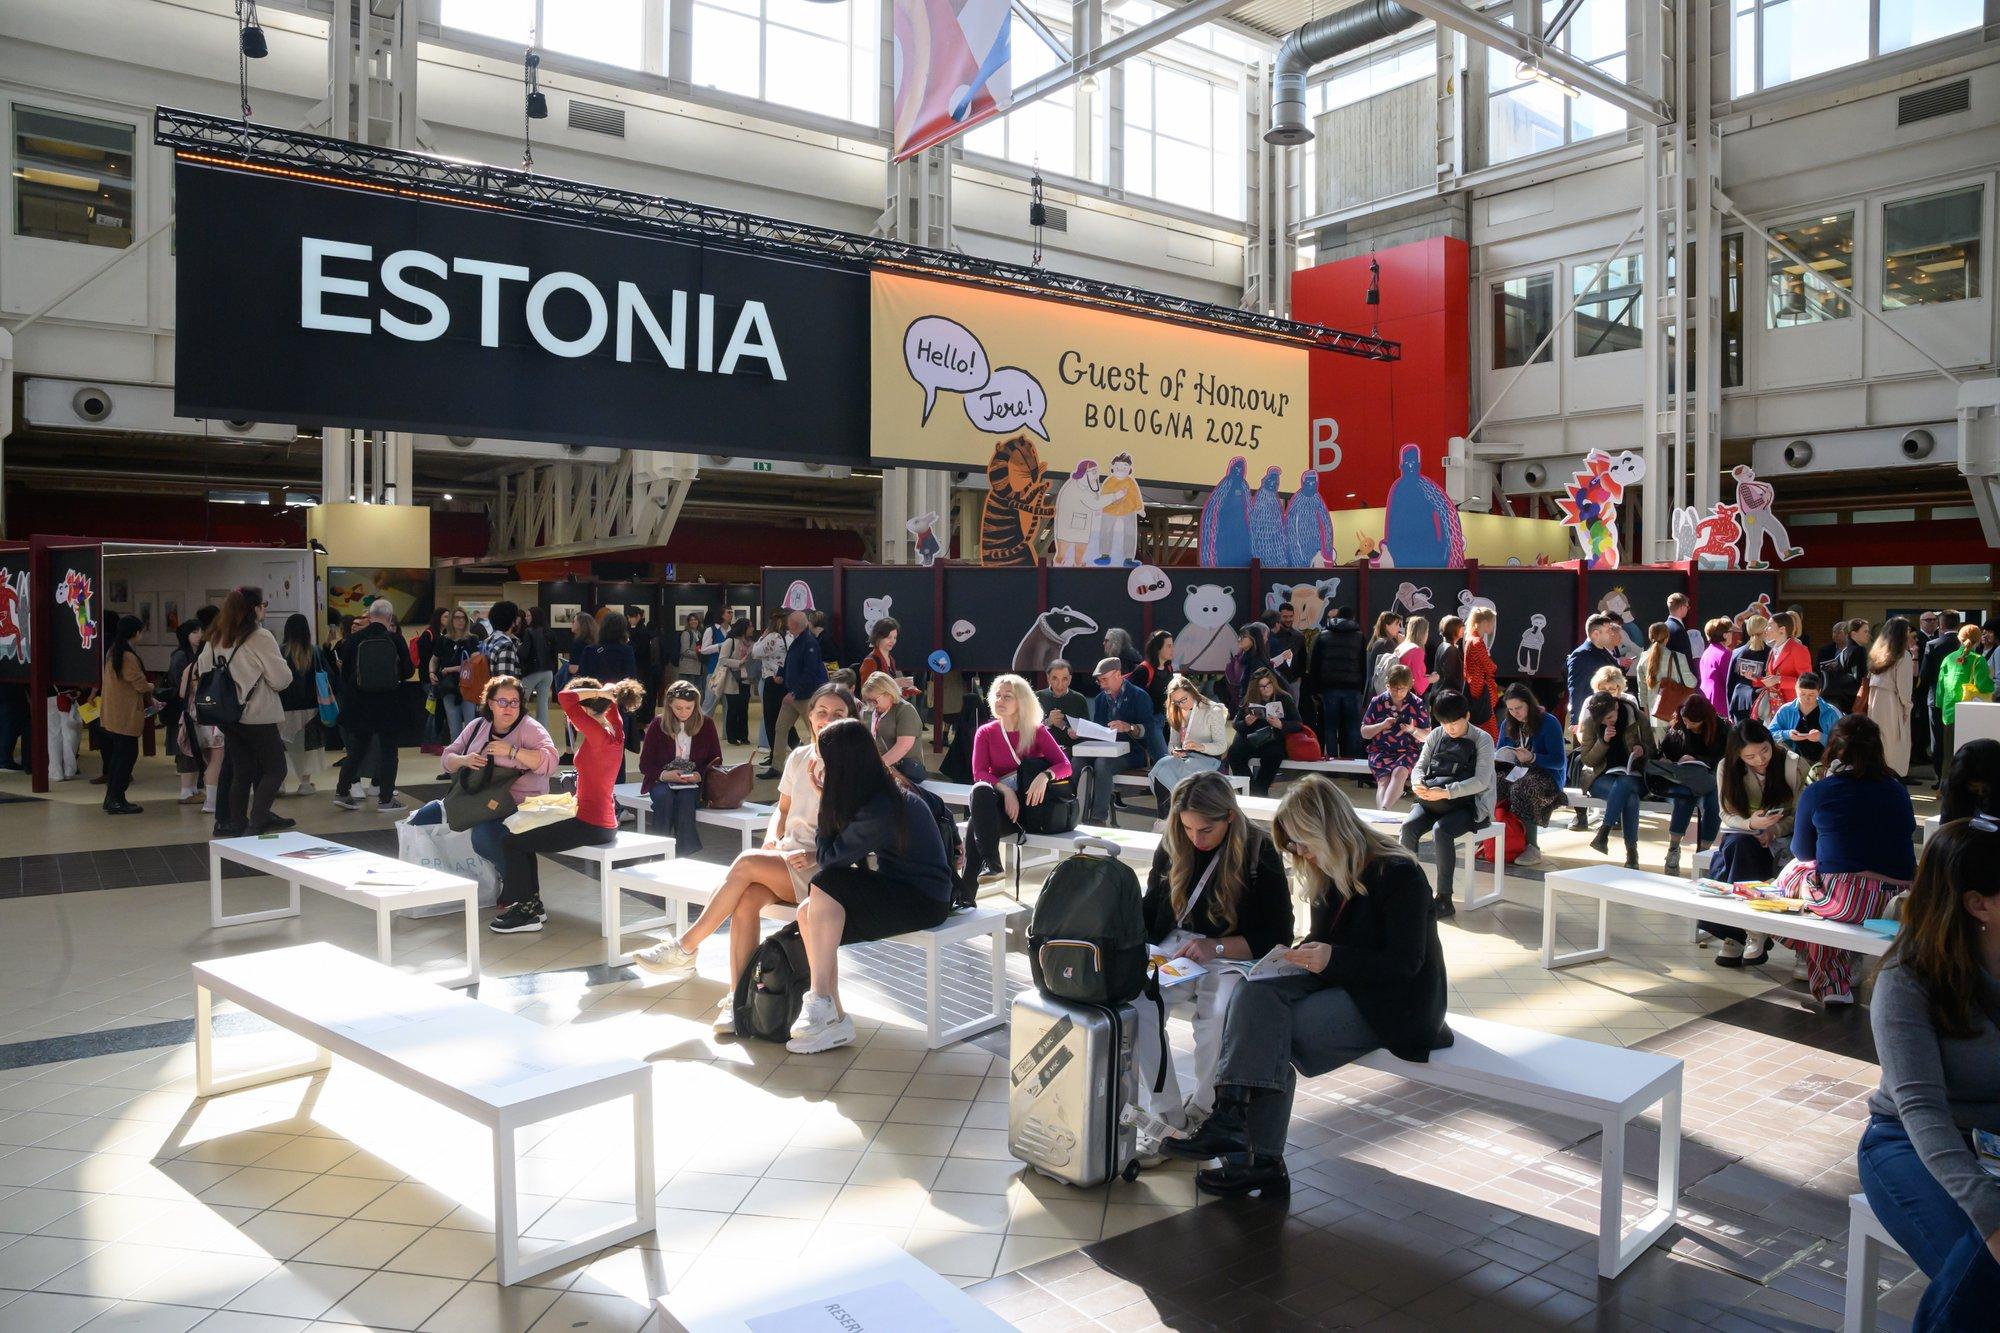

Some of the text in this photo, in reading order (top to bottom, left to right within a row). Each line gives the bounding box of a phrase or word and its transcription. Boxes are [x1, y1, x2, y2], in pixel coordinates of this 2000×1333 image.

[302, 237, 787, 382] ESTONIA
[917, 338, 976, 375] Hello!
[1058, 350, 1290, 417] Guest of Honour
[1085, 403, 1263, 450] BOLOGNA 2025
[1313, 417, 1342, 473] B
